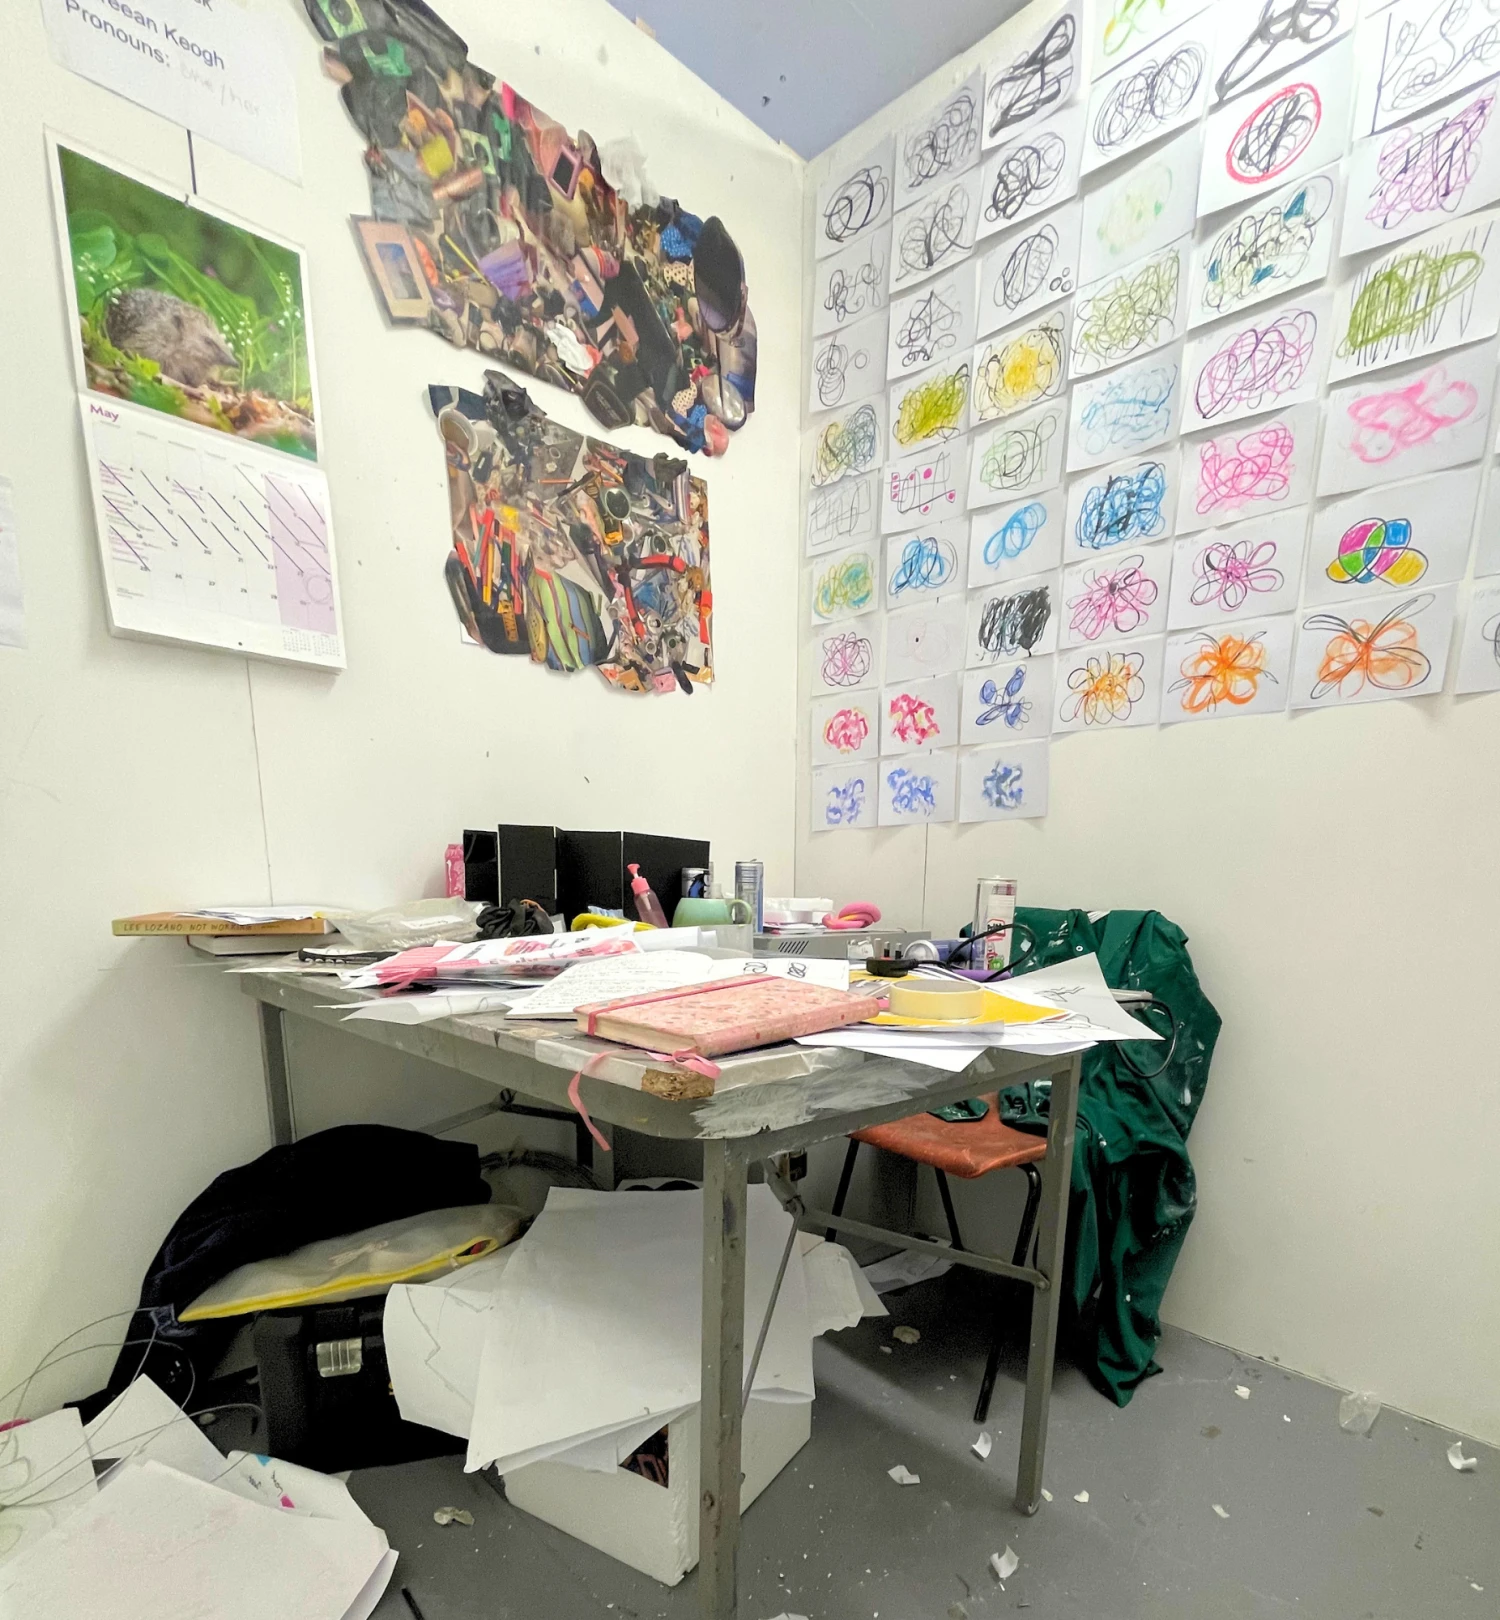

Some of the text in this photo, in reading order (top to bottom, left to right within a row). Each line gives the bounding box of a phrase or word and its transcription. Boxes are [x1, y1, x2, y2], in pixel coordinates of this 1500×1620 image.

[65, 0, 171, 67] Pronouns:
[164, 23, 225, 70] Keogh
[90, 403, 119, 423] May
[123, 923, 140, 932] LEE
[144, 922, 183, 932] LOZANO
[190, 923, 206, 932] NOT
